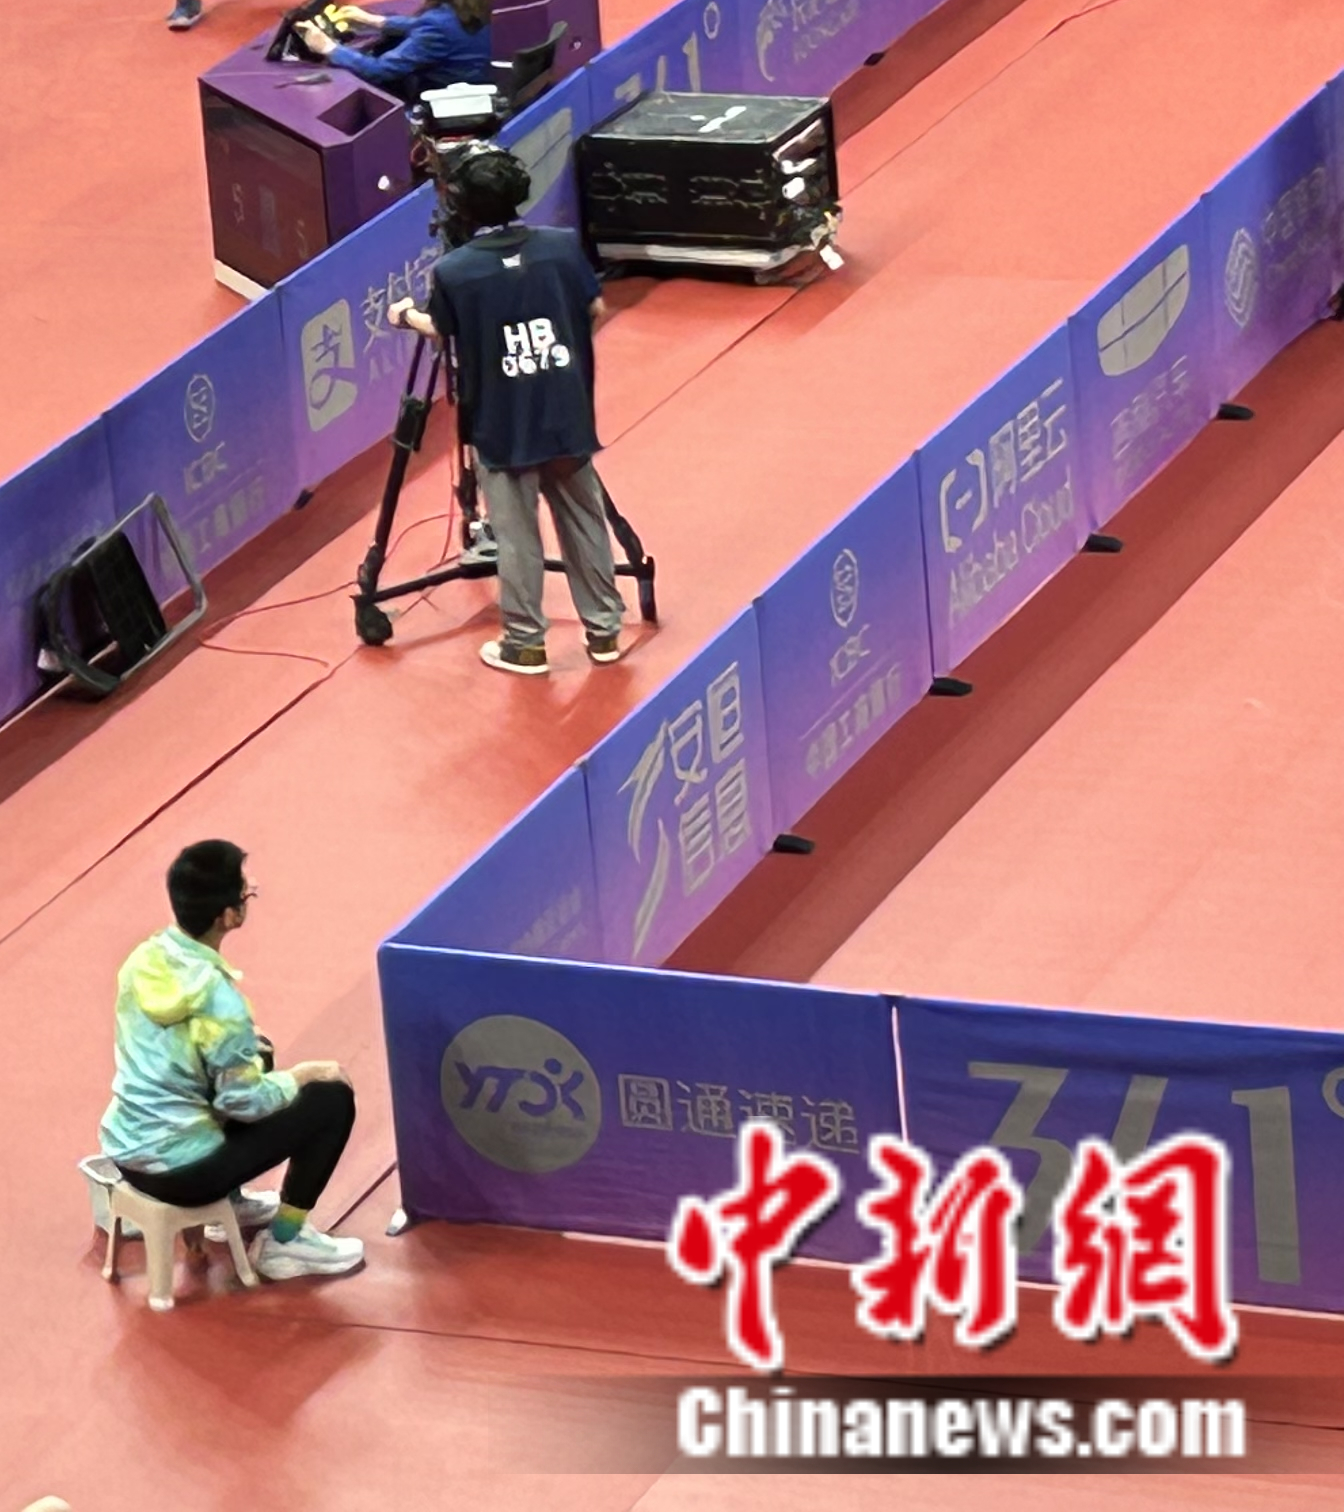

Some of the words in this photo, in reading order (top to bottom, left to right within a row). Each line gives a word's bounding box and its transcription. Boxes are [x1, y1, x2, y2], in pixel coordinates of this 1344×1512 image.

[503, 317, 557, 357] HB
[618, 1073, 861, 1154] 圆通速递
